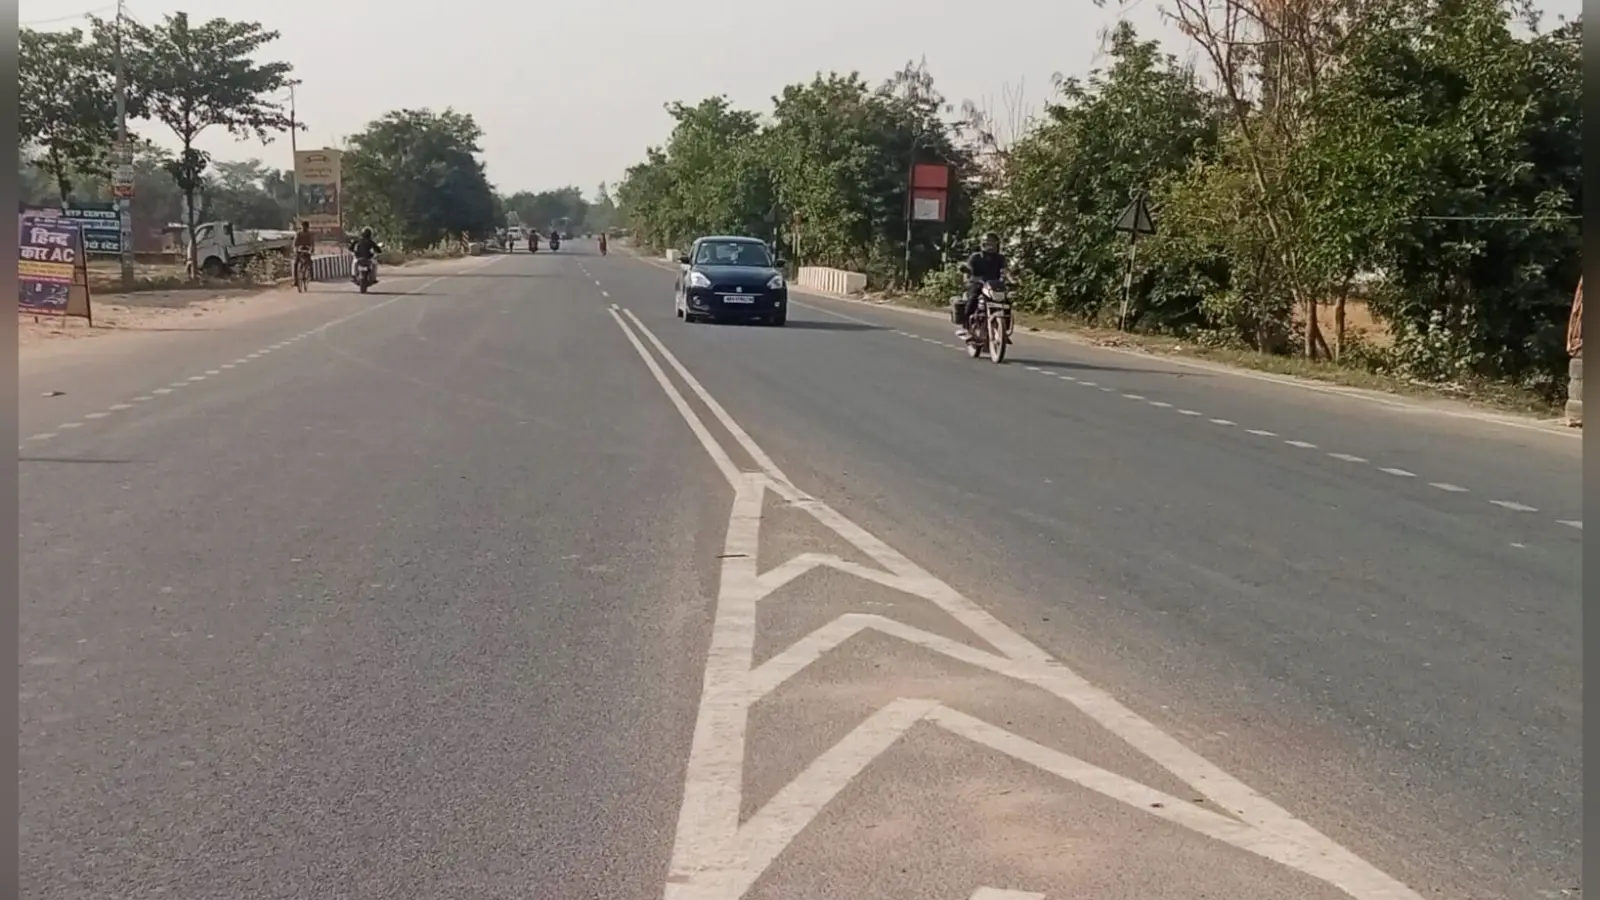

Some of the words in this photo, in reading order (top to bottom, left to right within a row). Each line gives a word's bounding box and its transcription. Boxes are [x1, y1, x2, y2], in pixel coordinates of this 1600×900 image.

[83, 210, 116, 219] CENTER
[19, 245, 49, 260] कार
[50, 247, 75, 262] AC
